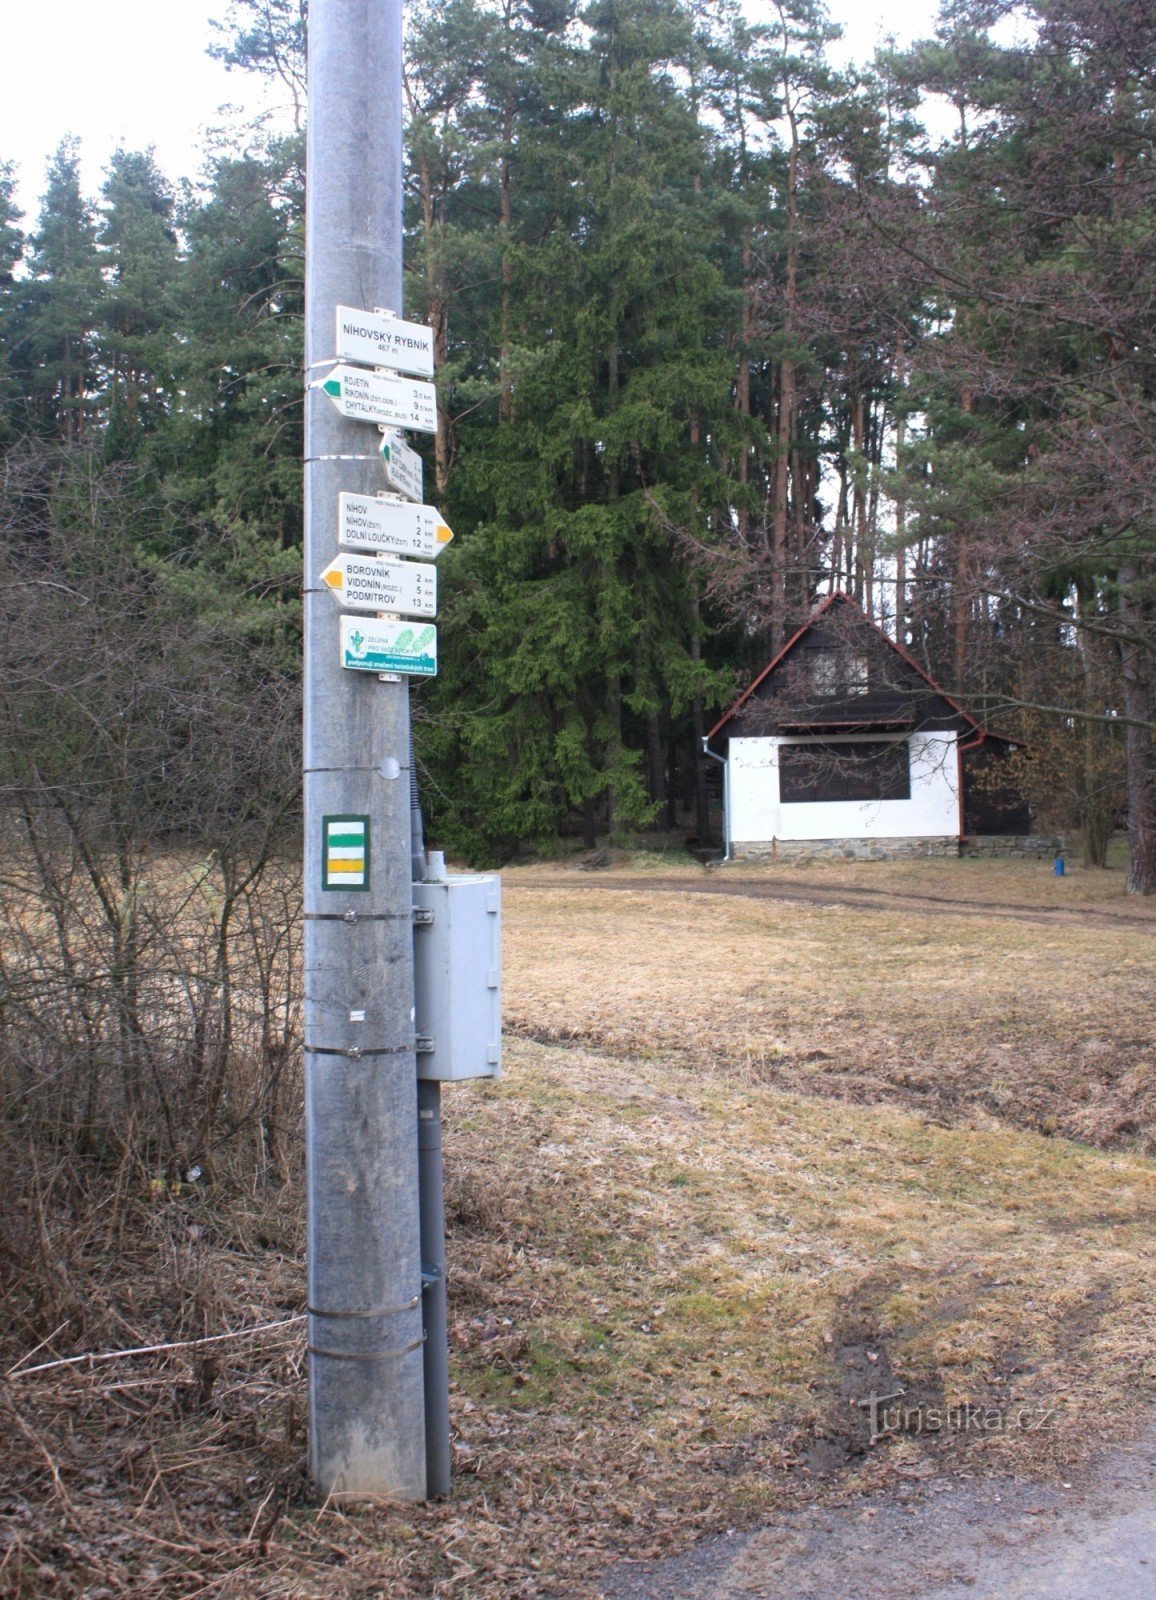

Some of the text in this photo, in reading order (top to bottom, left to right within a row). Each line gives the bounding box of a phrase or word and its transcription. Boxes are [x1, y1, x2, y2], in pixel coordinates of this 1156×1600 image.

[343, 323, 428, 351] NÍHOVSKÝ RYBNÍK
[378, 343, 389, 352] 467
[344, 375, 369, 388] ROJETÍN
[410, 412, 419, 422] 14
[346, 502, 367, 514] NÍHOV
[346, 529, 367, 540] DOLNÍ
[416, 527, 420, 535] 2
[346, 564, 390, 577] BOROVNÍK
[416, 574, 421, 582] 2
[346, 577, 380, 589] VIDONÍN
[416, 586, 421, 594] 5
[346, 590, 395, 603] PODMITROV
[412, 598, 421, 607] 13
